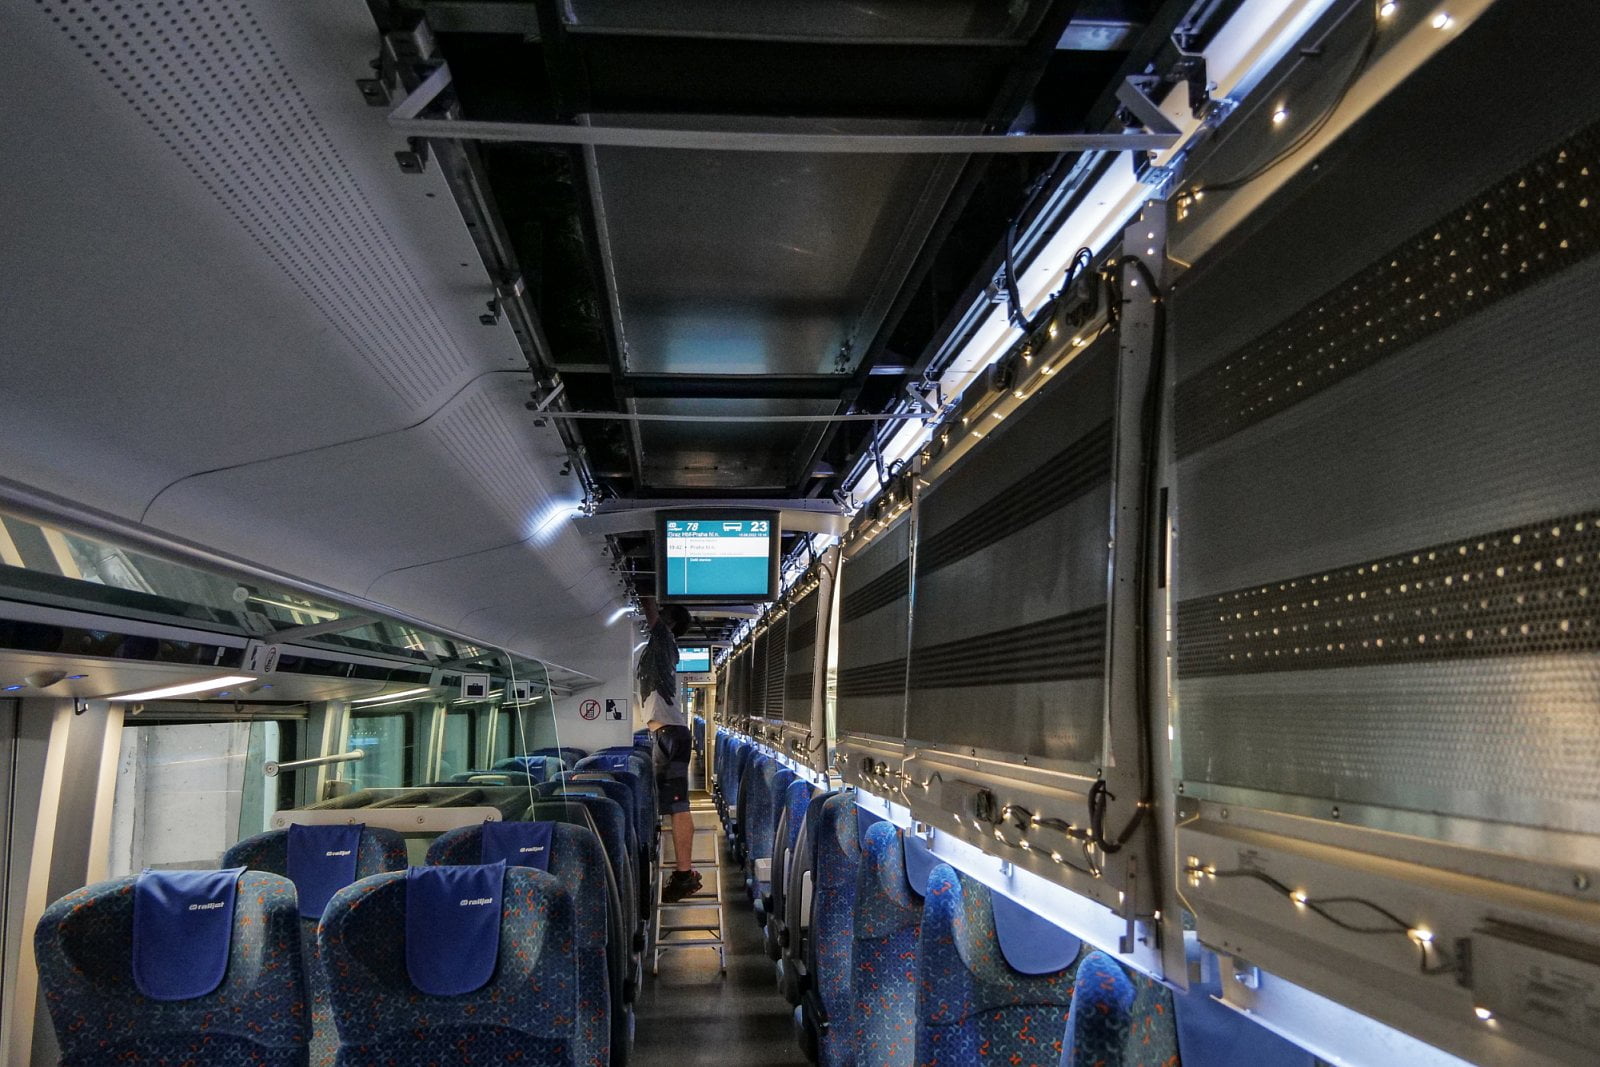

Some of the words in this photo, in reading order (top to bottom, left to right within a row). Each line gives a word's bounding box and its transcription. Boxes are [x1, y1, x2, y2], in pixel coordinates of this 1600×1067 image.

[686, 522, 699, 531] 78
[750, 521, 768, 532] 23
[198, 901, 225, 910] railjet
[468, 897, 493, 906] railjet
